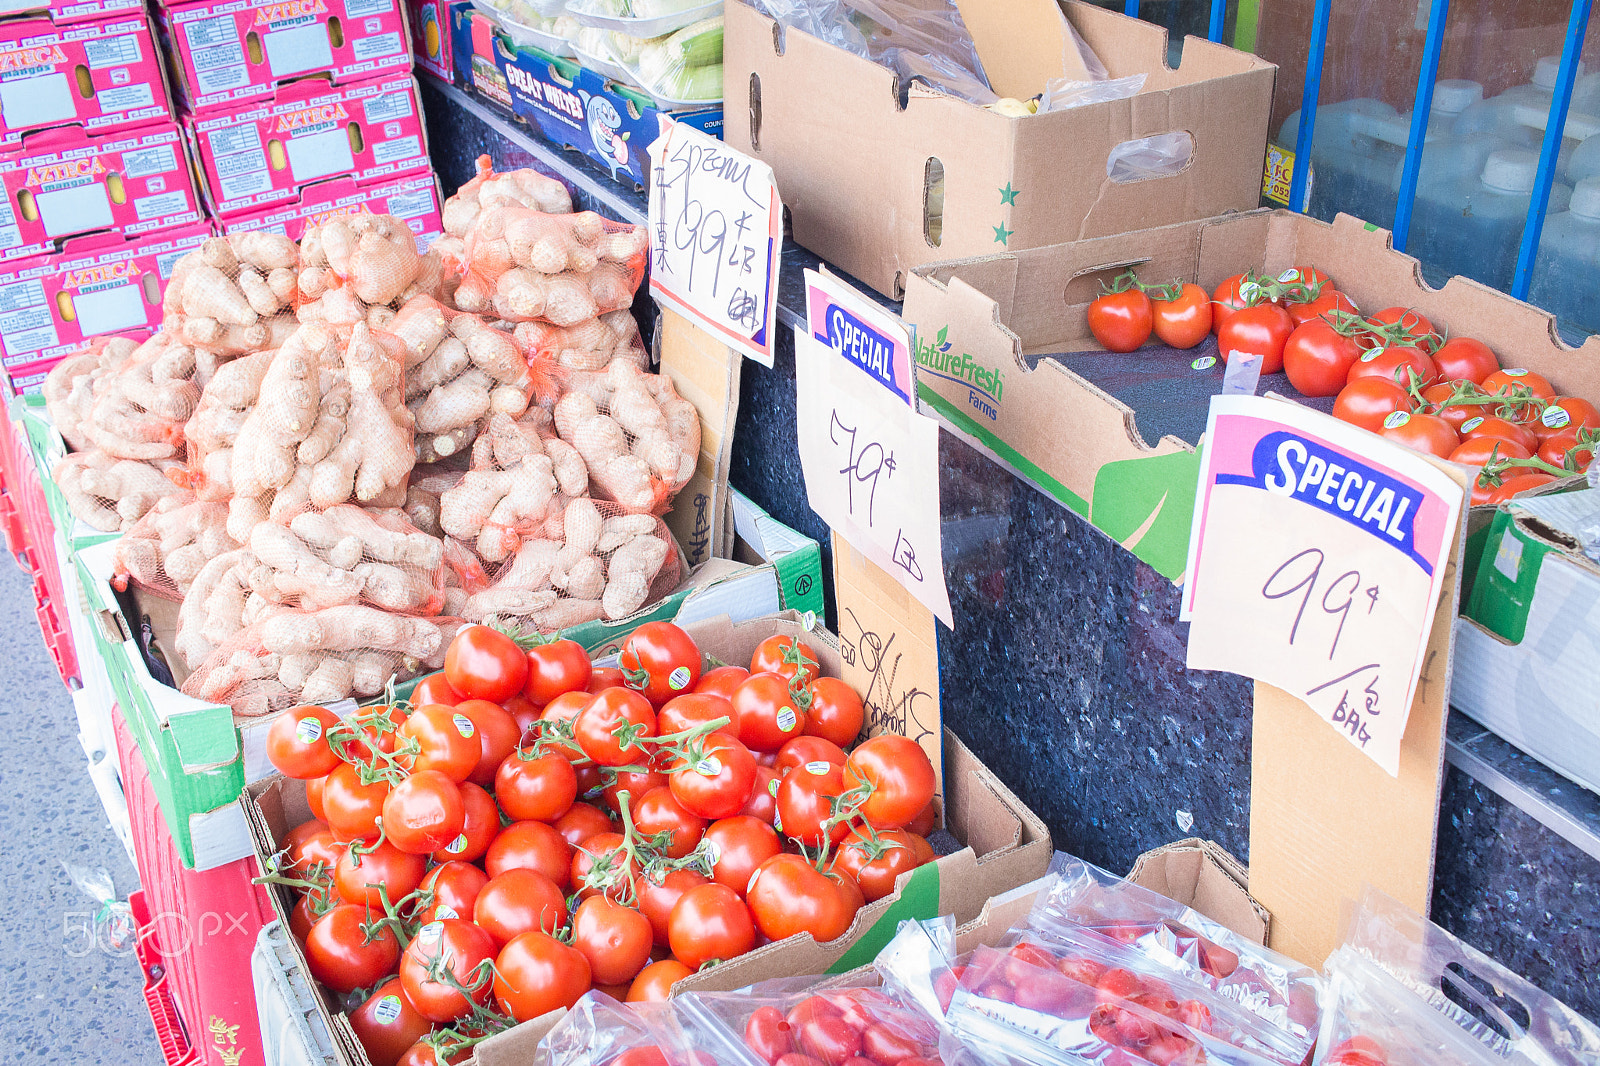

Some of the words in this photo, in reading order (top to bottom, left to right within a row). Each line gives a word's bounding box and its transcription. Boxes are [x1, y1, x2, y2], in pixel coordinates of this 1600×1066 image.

[254, 0, 328, 26] AZTECA
[270, 15, 315, 29] mangos
[0, 45, 68, 73] ZTECA
[505, 63, 543, 101] GREAT
[542, 82, 584, 120] WHITES
[276, 103, 349, 133] AZTECA
[292, 121, 335, 136] mangos
[25, 157, 106, 187] AZTECA
[44, 178, 93, 192] mangos
[63, 260, 141, 289] AZTECA
[81, 279, 129, 294] mangos
[831, 309, 892, 382] SPECIAL
[968, 390, 998, 421] Farms
[1264, 439, 1411, 542] SPECIAL
